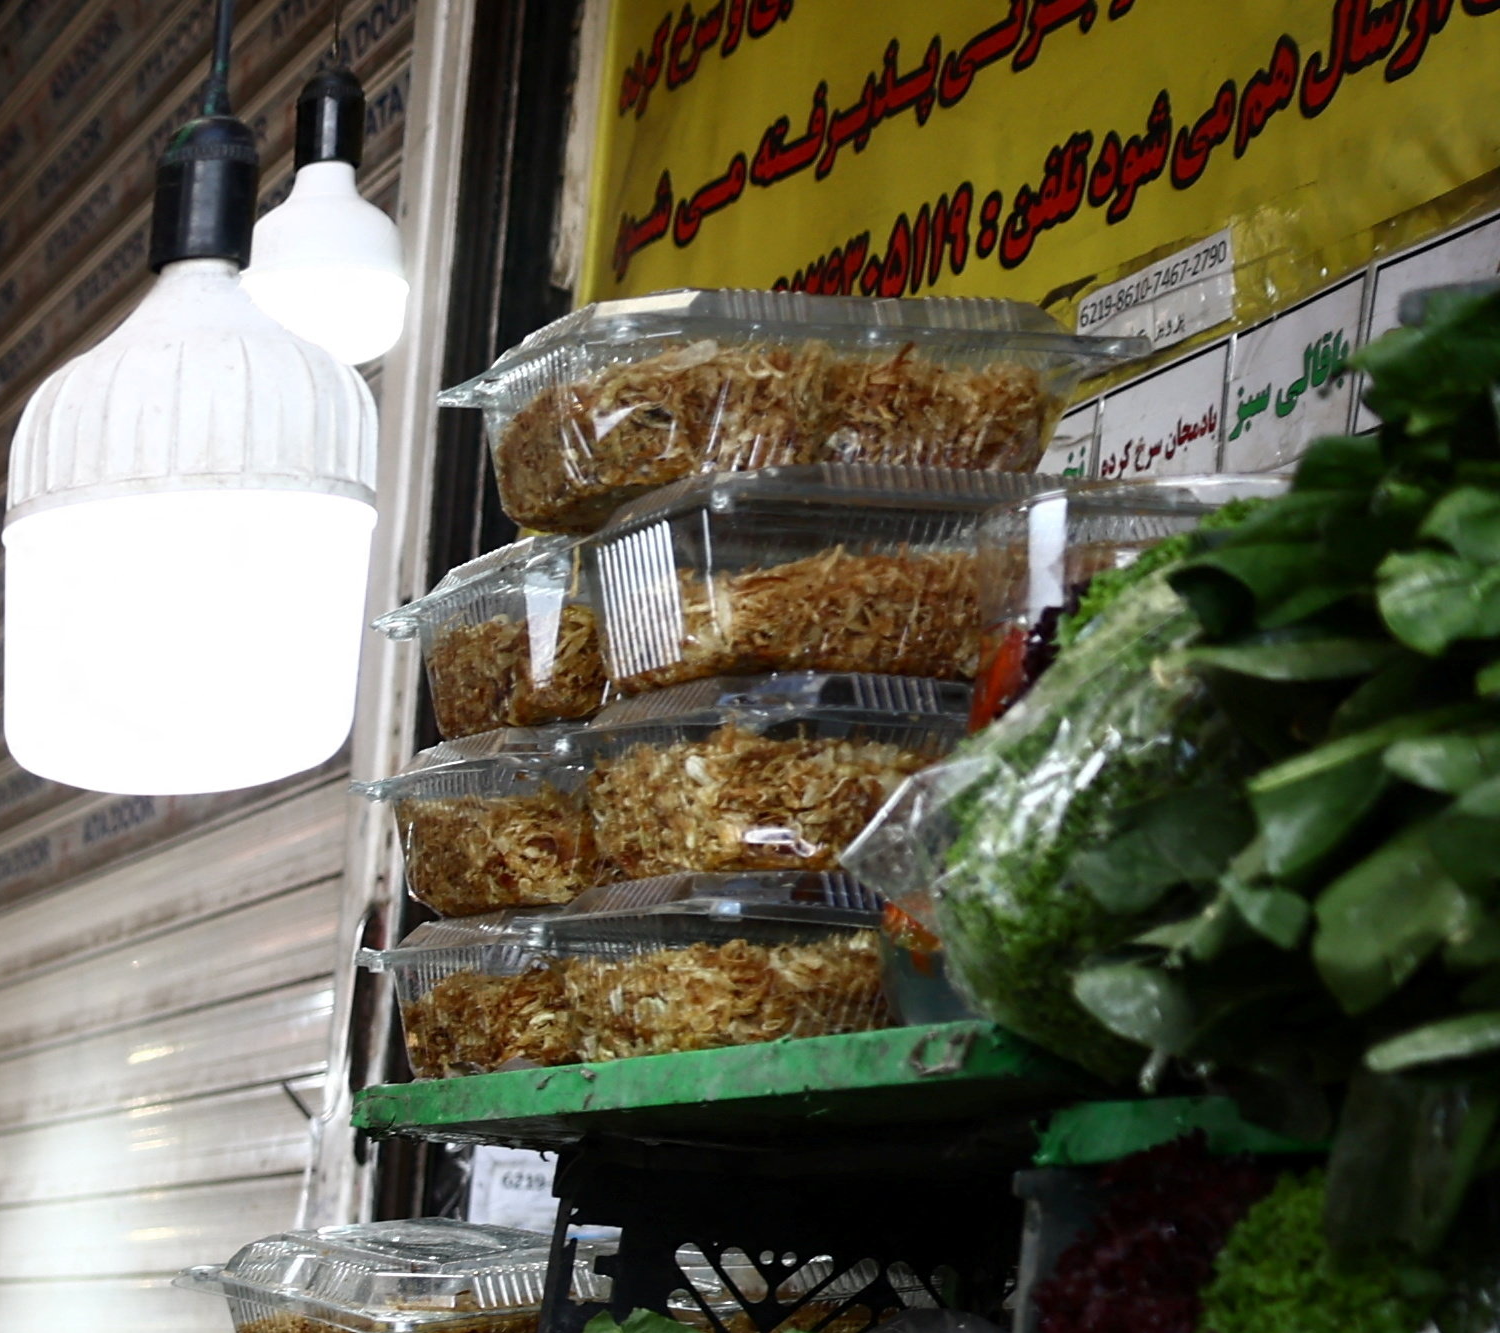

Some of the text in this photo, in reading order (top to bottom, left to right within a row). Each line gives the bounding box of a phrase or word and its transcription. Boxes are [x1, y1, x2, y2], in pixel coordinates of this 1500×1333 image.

[751, 34, 940, 187] پذیرفته
[1171, 79, 1237, 191] می
[1233, 33, 1300, 159] هم
[673, 152, 747, 248] می
[1000, 130, 1094, 270] تلفن
[1088, 89, 1172, 226] شود
[1078, 239, 1228, 329] 6219-8610-7467-2790
[1101, 432, 1134, 481] کرده
[1134, 436, 1164, 477] سرخ
[1164, 403, 1218, 461] بادمجان
[1229, 381, 1271, 442] سبز
